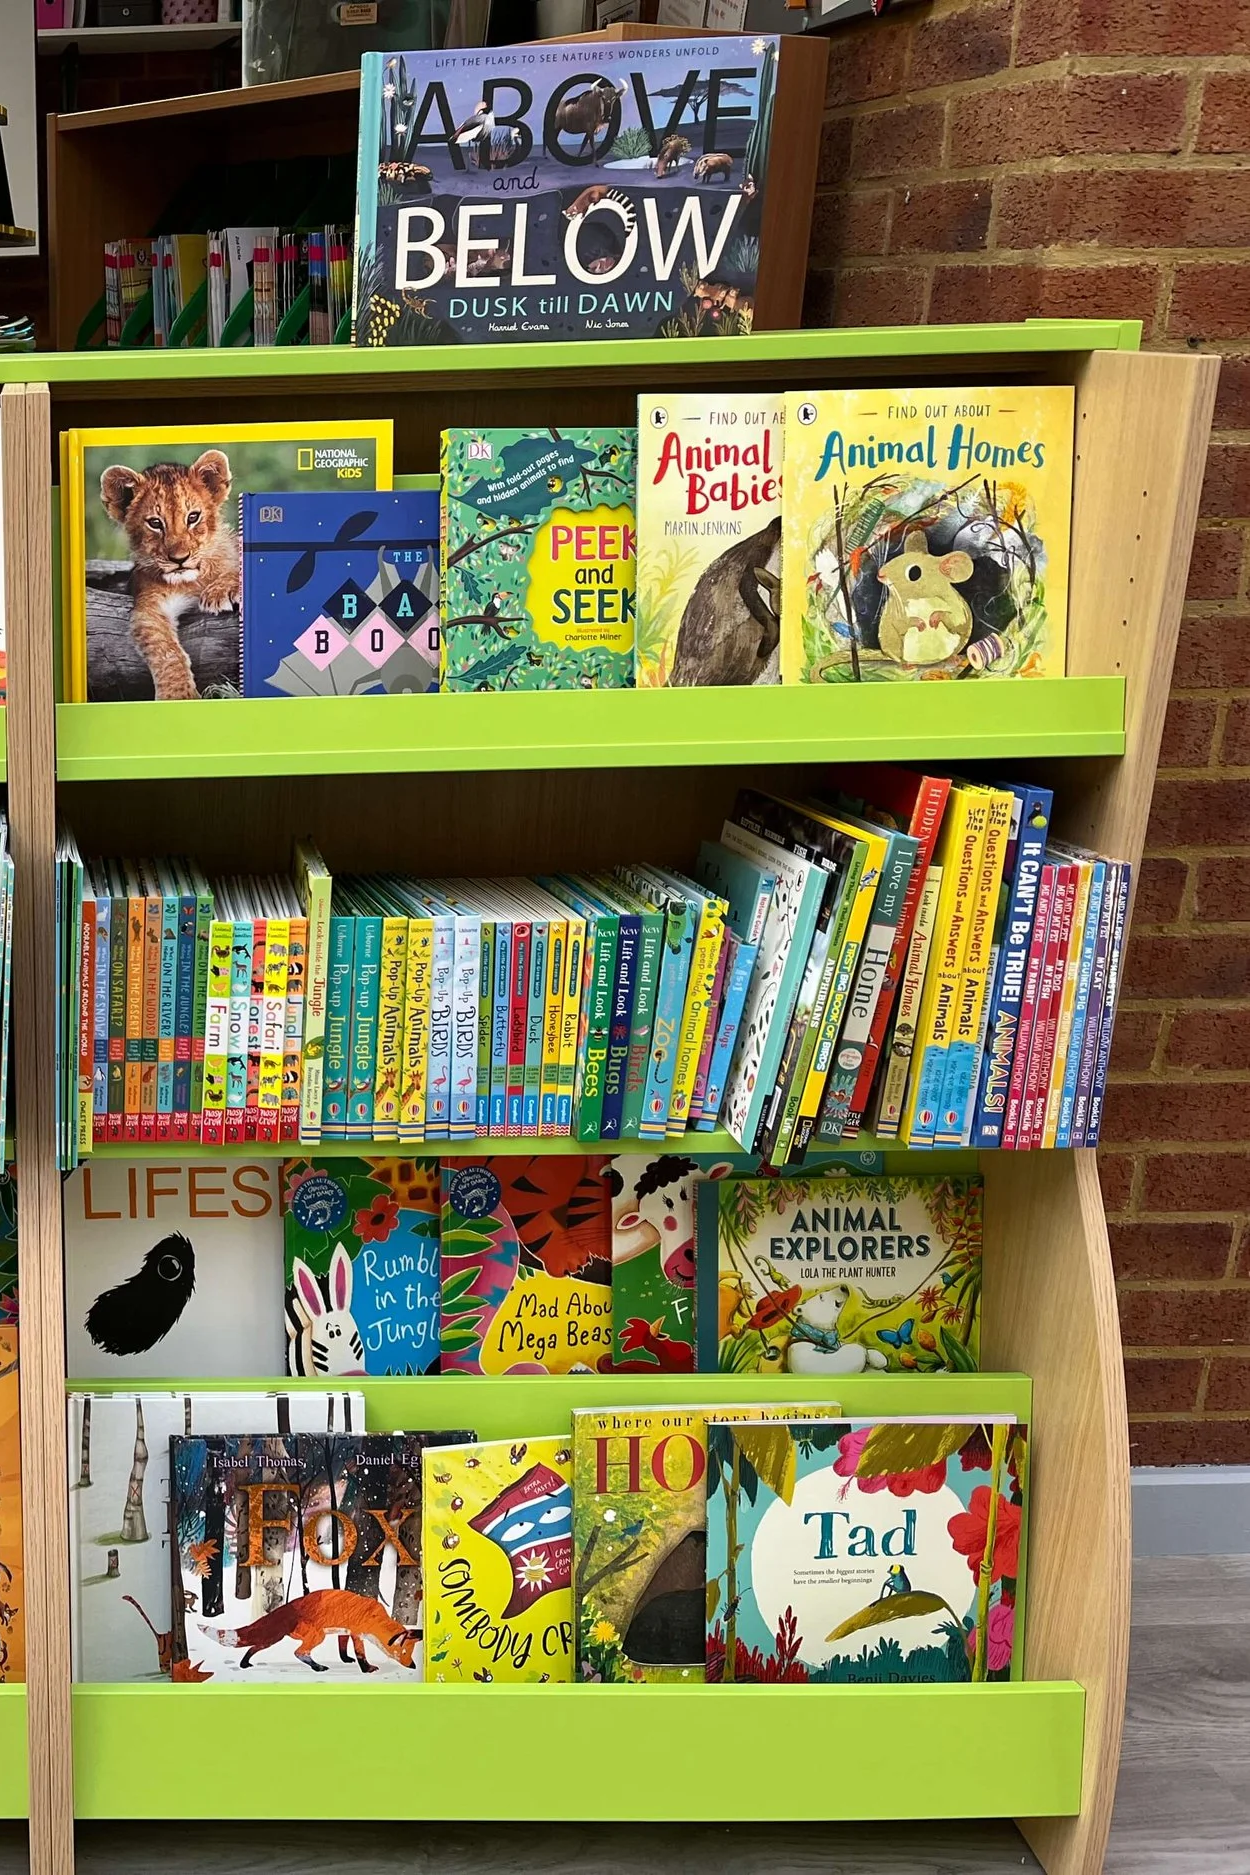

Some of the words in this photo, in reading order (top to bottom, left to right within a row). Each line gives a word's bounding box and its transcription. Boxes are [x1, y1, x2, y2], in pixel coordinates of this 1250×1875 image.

[435, 57, 457, 67] LIFT
[461, 56, 480, 66] THE
[484, 55, 518, 65] FLAPS
[522, 54, 537, 64] TO
[539, 53, 558, 63] SEE
[562, 50, 614, 62] NATURE'S
[618, 48, 671, 59] WONDERS
[675, 46, 720, 57] UNFOLD
[408, 67, 758, 171] ABOVE
[493, 166, 540, 191] and
[395, 194, 742, 290] BELOW
[449, 297, 528, 318] DUSK
[538, 297, 568, 315] till
[578, 291, 673, 314] DAWN
[521, 321, 550, 331] Evans
[585, 320, 601, 328] Nic
[604, 319, 629, 328] Jones
[708, 411, 738, 425] FIND
[744, 410, 766, 425] OUT
[887, 405, 918, 420] FIND
[922, 404, 948, 419] OUT
[953, 404, 991, 418] ABOUT
[313, 457, 369, 469] GEOGRAPHIC
[314, 449, 358, 460] NATIONAL
[470, 444, 491, 458] DK
[652, 428, 774, 485] Animal
[813, 425, 937, 483] Animal
[948, 423, 1045, 470] Homes
[477, 495, 492, 506] and
[494, 486, 519, 503] hidden
[520, 469, 547, 491] animals
[547, 463, 557, 473] to
[558, 455, 575, 467] find
[488, 478, 506, 492] With
[506, 464, 536, 485] fold-out
[535, 450, 559, 468] pages
[552, 524, 637, 560] PEEK
[663, 520, 699, 536] MARTIN
[700, 520, 742, 536] JENKINS
[393, 551, 423, 564] THE
[575, 564, 613, 584] and
[552, 588, 636, 623] SEEK
[1021, 842, 1042, 856] It
[888, 862, 911, 896] love
[1013, 860, 1040, 922] CAN'T
[878, 899, 894, 917] my
[1009, 924, 1031, 946] Be
[599, 941, 612, 964] Lift
[358, 964, 377, 1008] Pop-up
[598, 966, 610, 991] and
[851, 946, 888, 1019] Home
[1001, 947, 1028, 1002] TRUE!
[594, 992, 609, 1021] Look
[208, 1004, 226, 1048] Farm
[229, 1001, 248, 1050] Snow
[264, 1001, 284, 1052] Safari
[382, 1004, 404, 1066] Animals
[528, 1015, 542, 1044] Duck
[546, 1005, 561, 1054] Honeybee
[564, 1014, 577, 1048] Rabbit
[354, 1015, 374, 1070] Jungle
[584, 1048, 606, 1097] Bees
[985, 1009, 1019, 1113] ANIMALS!
[790, 1206, 902, 1233] ANIMAL
[770, 1235, 931, 1262] EXPLORERS
[800, 1267, 820, 1279] LOLA
[822, 1267, 837, 1278] THE
[839, 1267, 863, 1278] PLANT
[866, 1266, 896, 1278] HUNTER
[515, 1294, 560, 1319] Mad
[497, 1322, 559, 1359] Mega
[598, 1415, 652, 1430] where
[662, 1415, 693, 1427] our
[212, 1455, 249, 1469] Isabel
[256, 1455, 303, 1468] Thomas
[356, 1453, 394, 1466] Daniel
[803, 1509, 917, 1560] Tad
[439, 1557, 533, 1669] SOMEBODY
